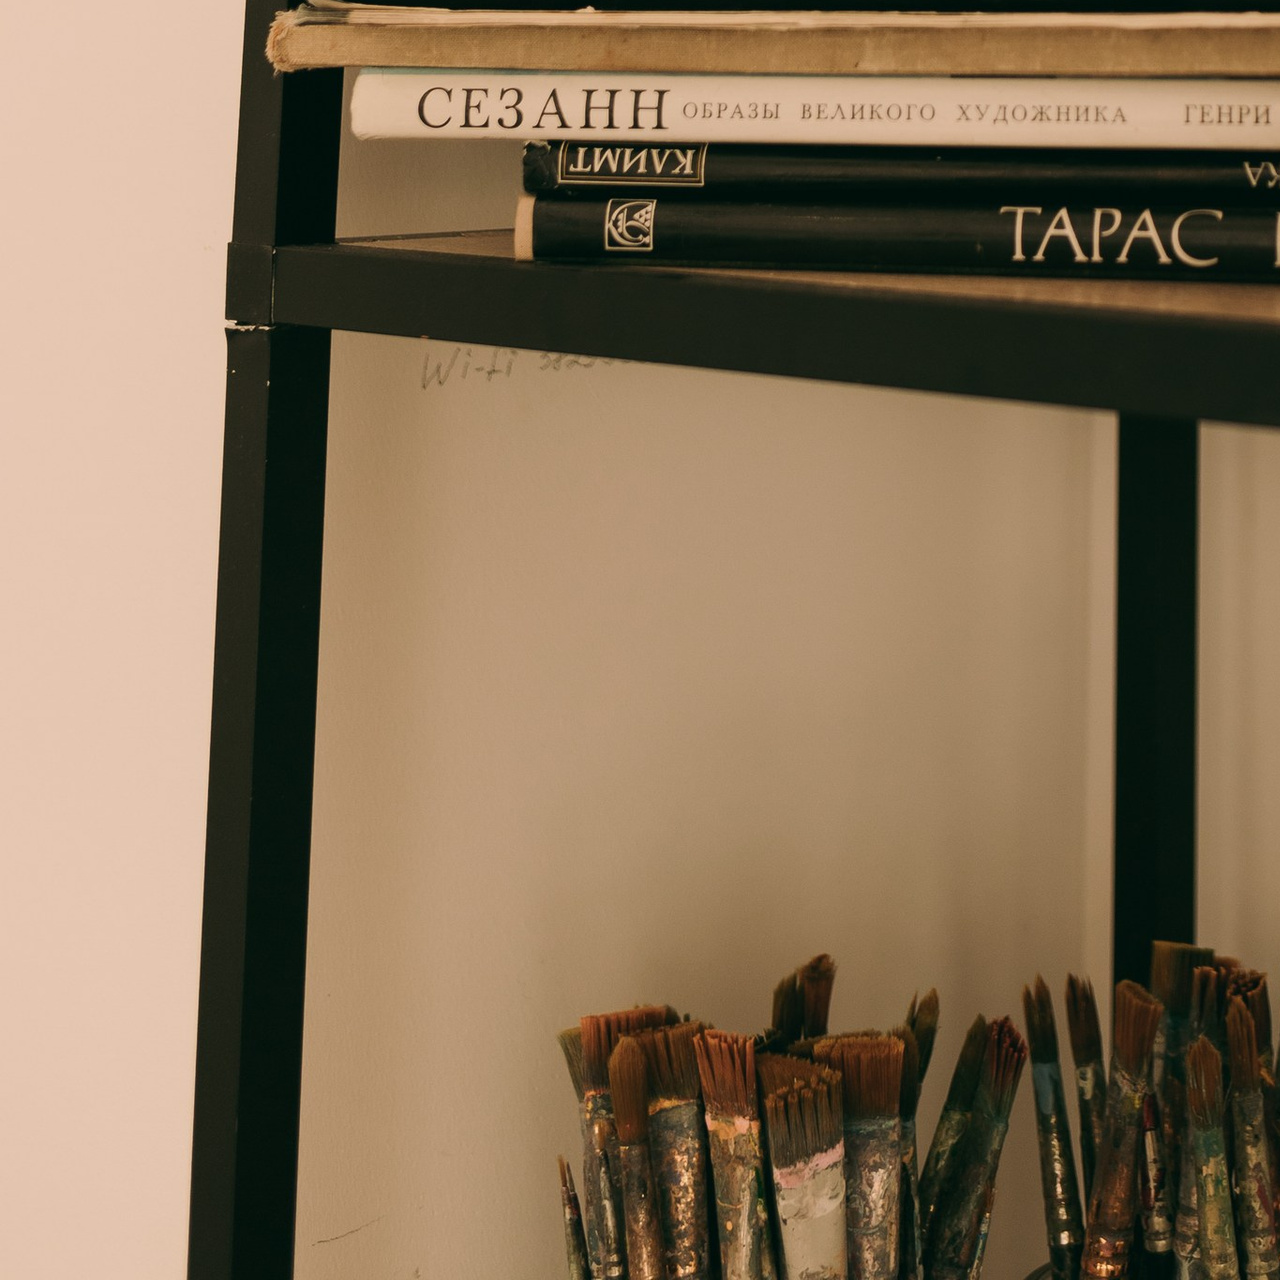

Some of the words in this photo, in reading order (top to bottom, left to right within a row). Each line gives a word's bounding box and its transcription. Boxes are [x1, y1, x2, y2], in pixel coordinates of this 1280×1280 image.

[416, 86, 671, 130] СЕЗАНН
[682, 101, 781, 120] ОБРАЗЫ
[801, 102, 937, 122] ВЕЛИКОГО
[956, 103, 1128, 126] ХУДОЖНИКА
[1183, 103, 1271, 125] ГЕНРИ
[570, 147, 695, 174] КЛИМТ
[1000, 206, 1223, 268] ТАРАС
